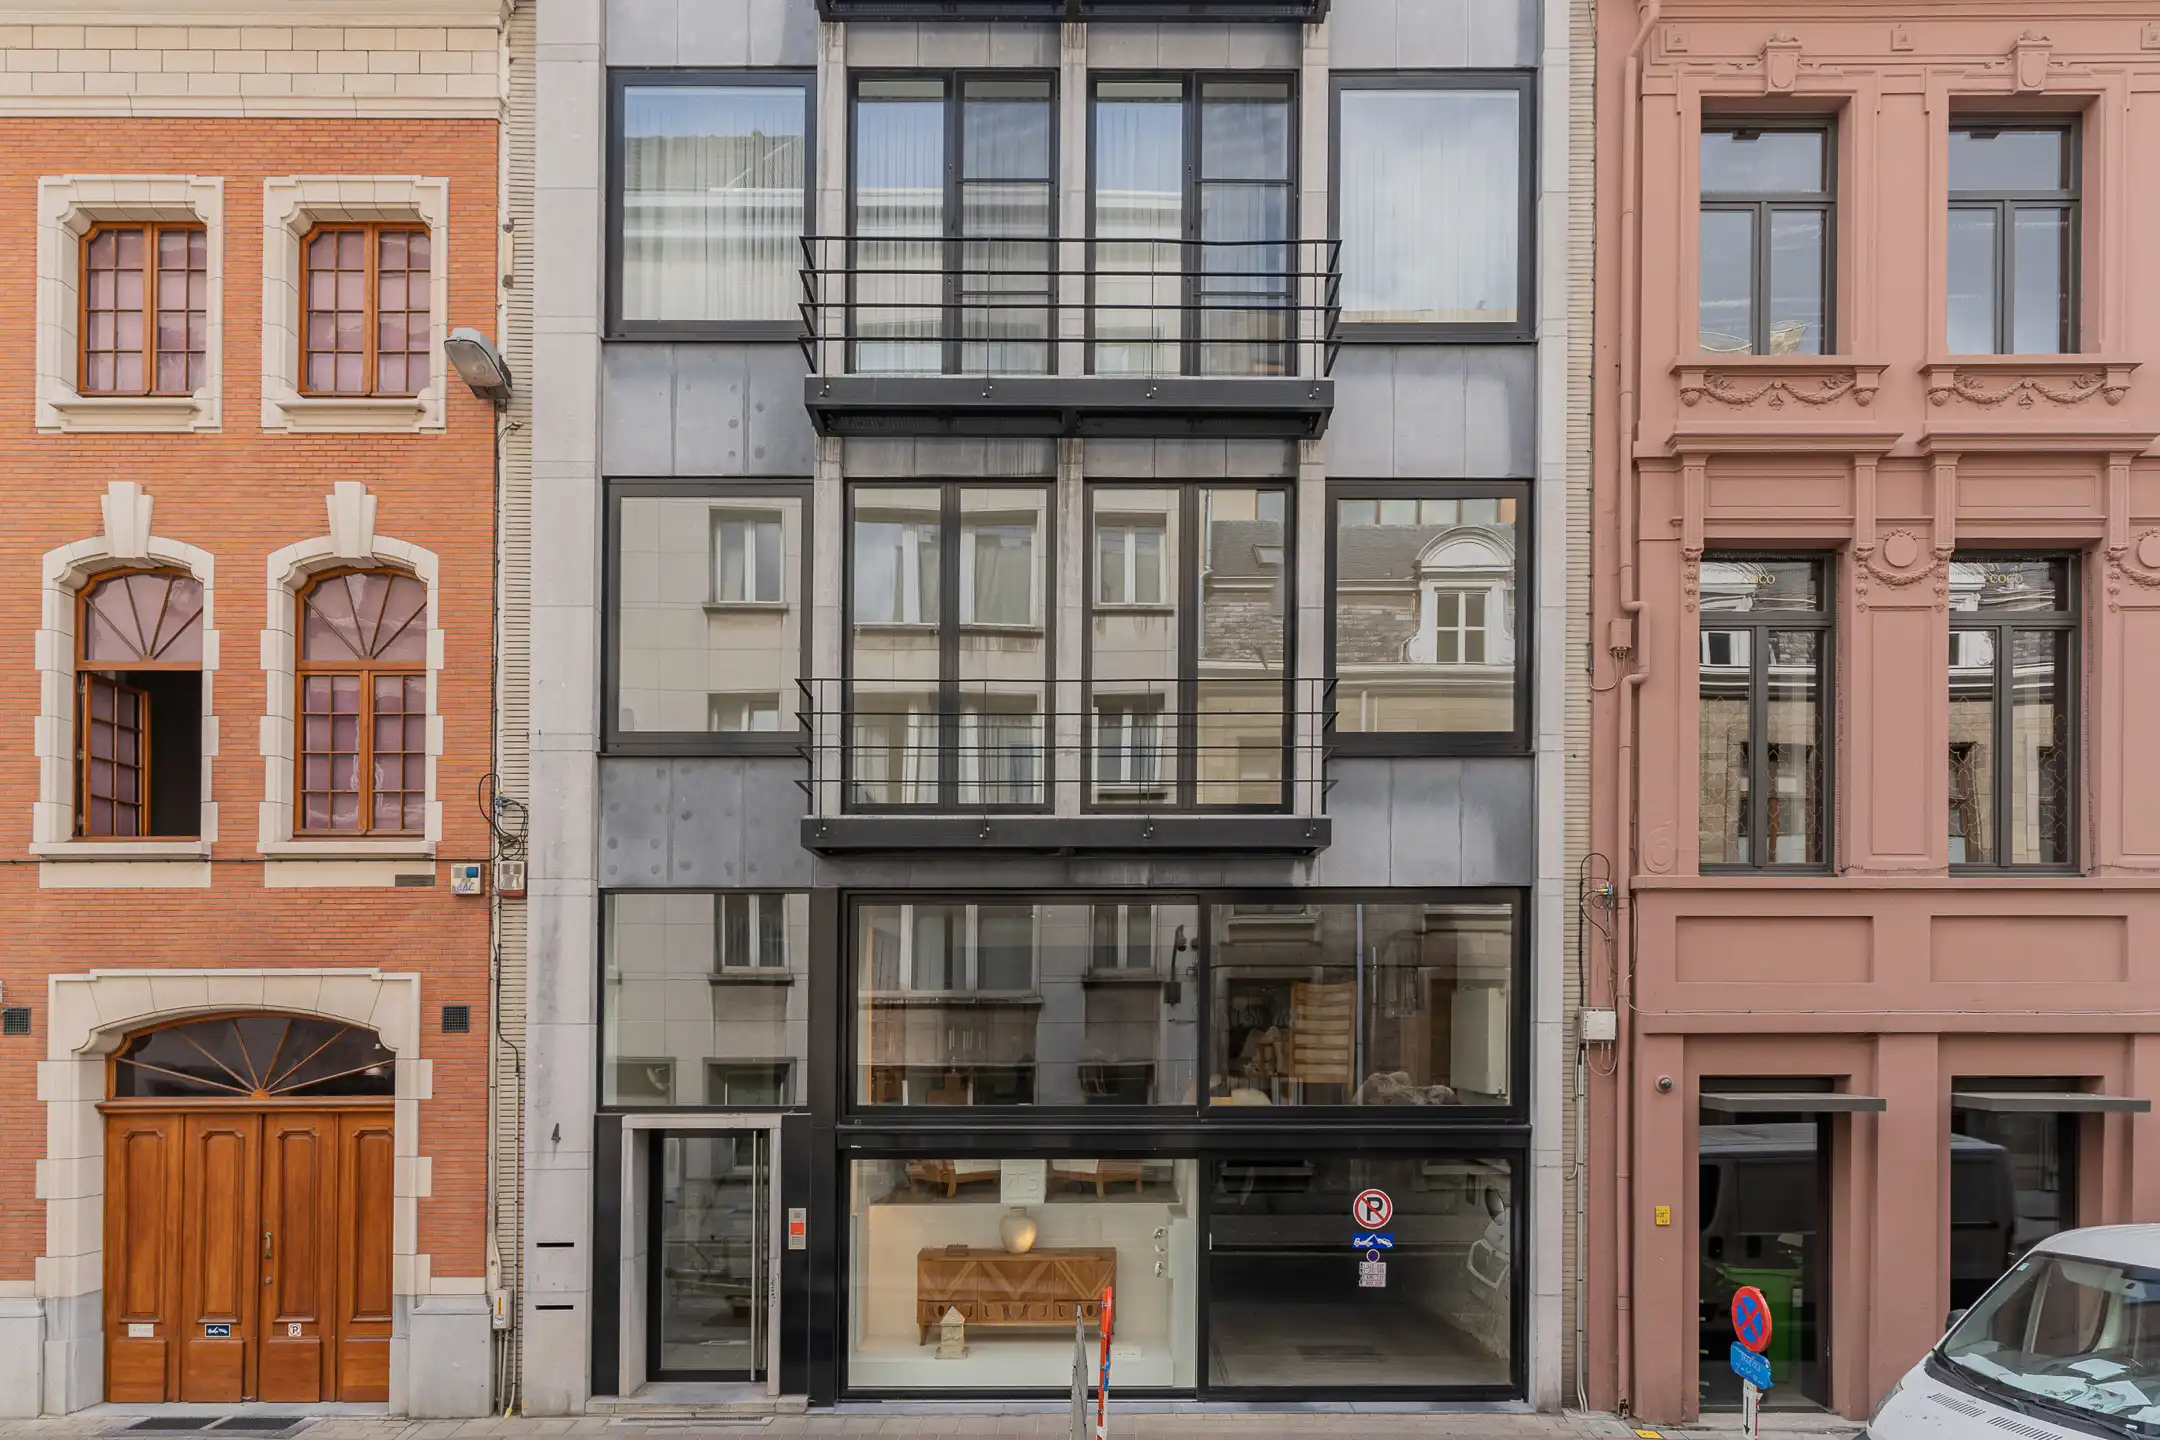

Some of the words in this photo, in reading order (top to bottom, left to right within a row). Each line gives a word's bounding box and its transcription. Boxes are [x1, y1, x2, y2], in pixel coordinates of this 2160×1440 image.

[1989, 574, 2024, 584] COCO
[551, 1122, 561, 1144] 4
[1366, 1196, 1384, 1222] P
